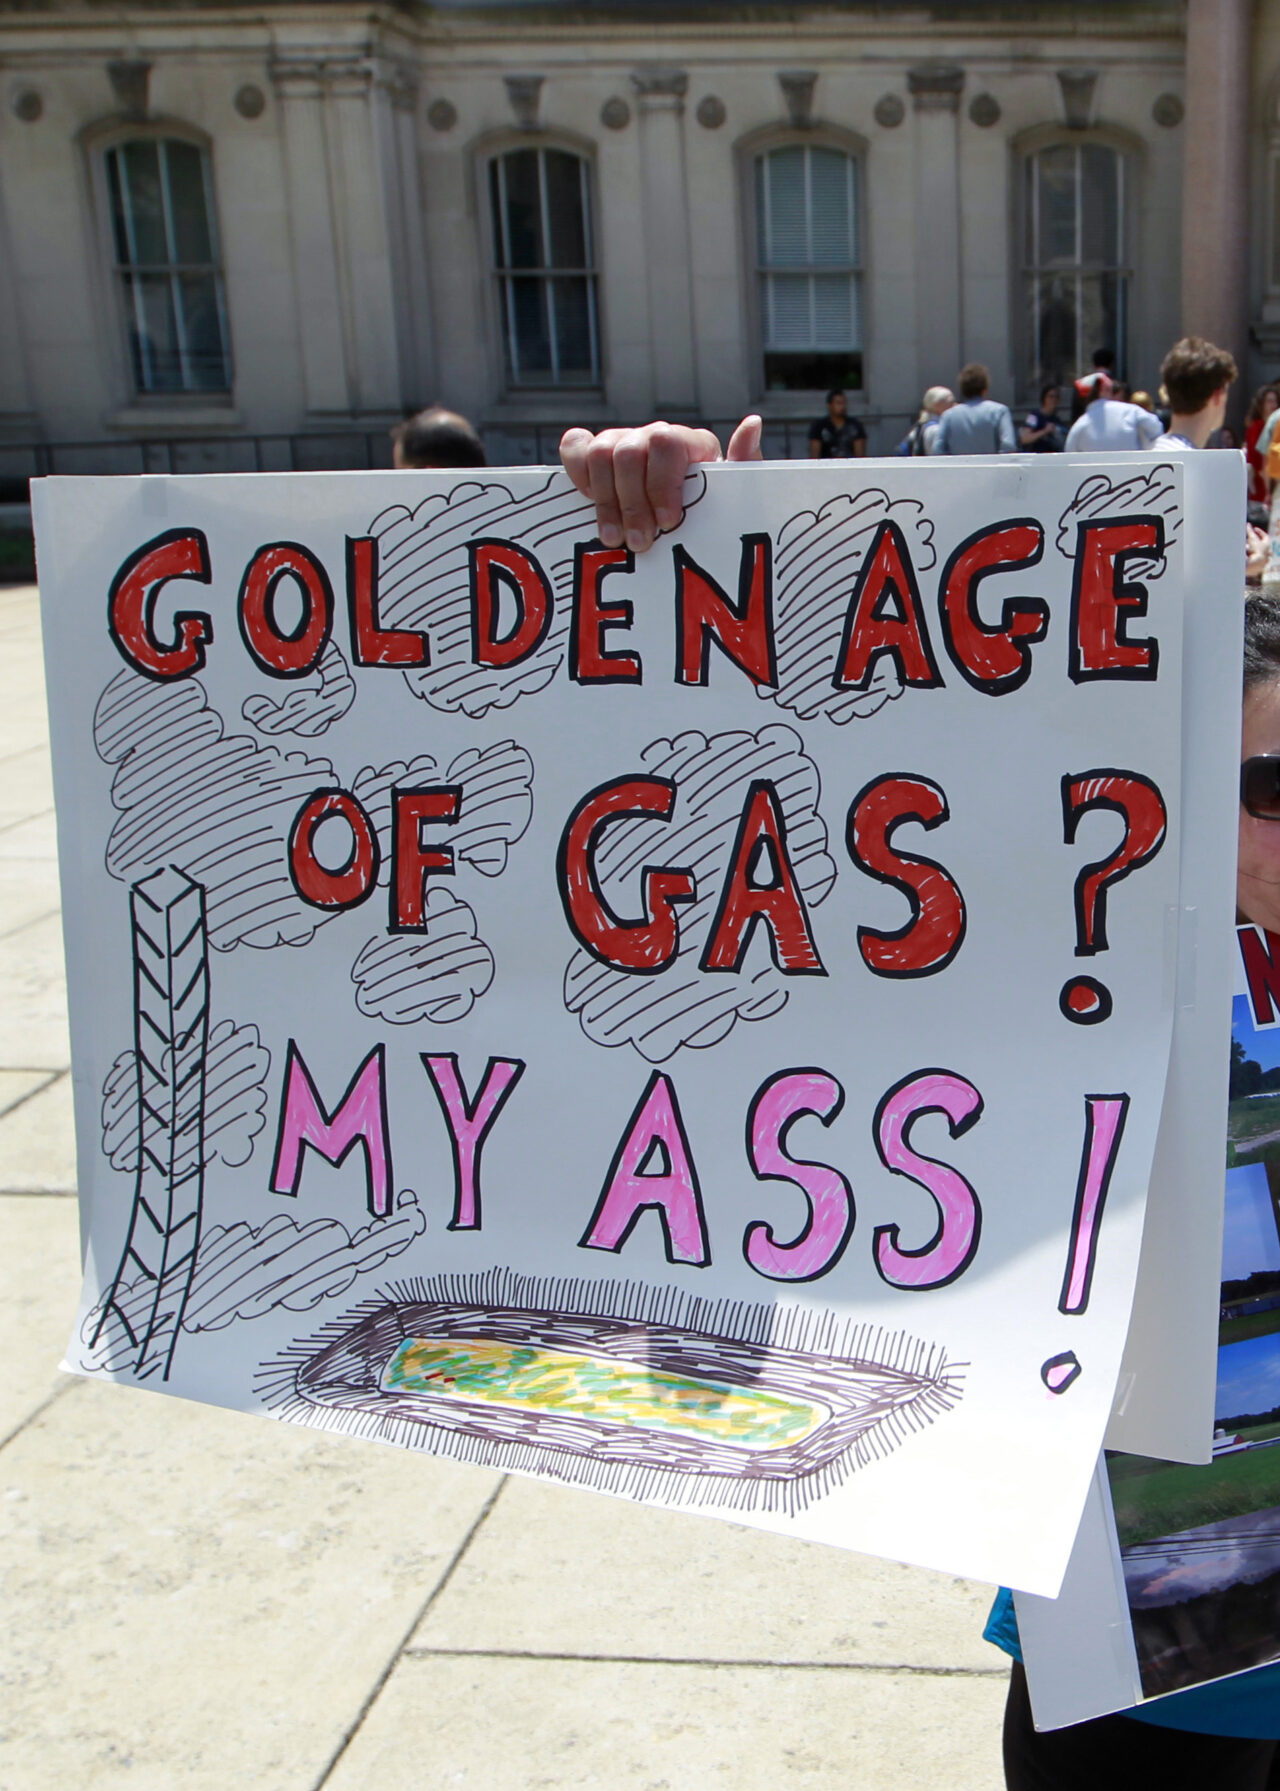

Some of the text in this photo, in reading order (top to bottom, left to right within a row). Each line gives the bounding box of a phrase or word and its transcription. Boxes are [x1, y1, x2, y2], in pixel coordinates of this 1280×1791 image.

[107, 514, 1165, 697] GOLDEN AGE
[288, 786, 464, 935] OF
[556, 771, 967, 980] GAS
[268, 1037, 527, 1232] MY
[577, 1066, 985, 1291] ASS
